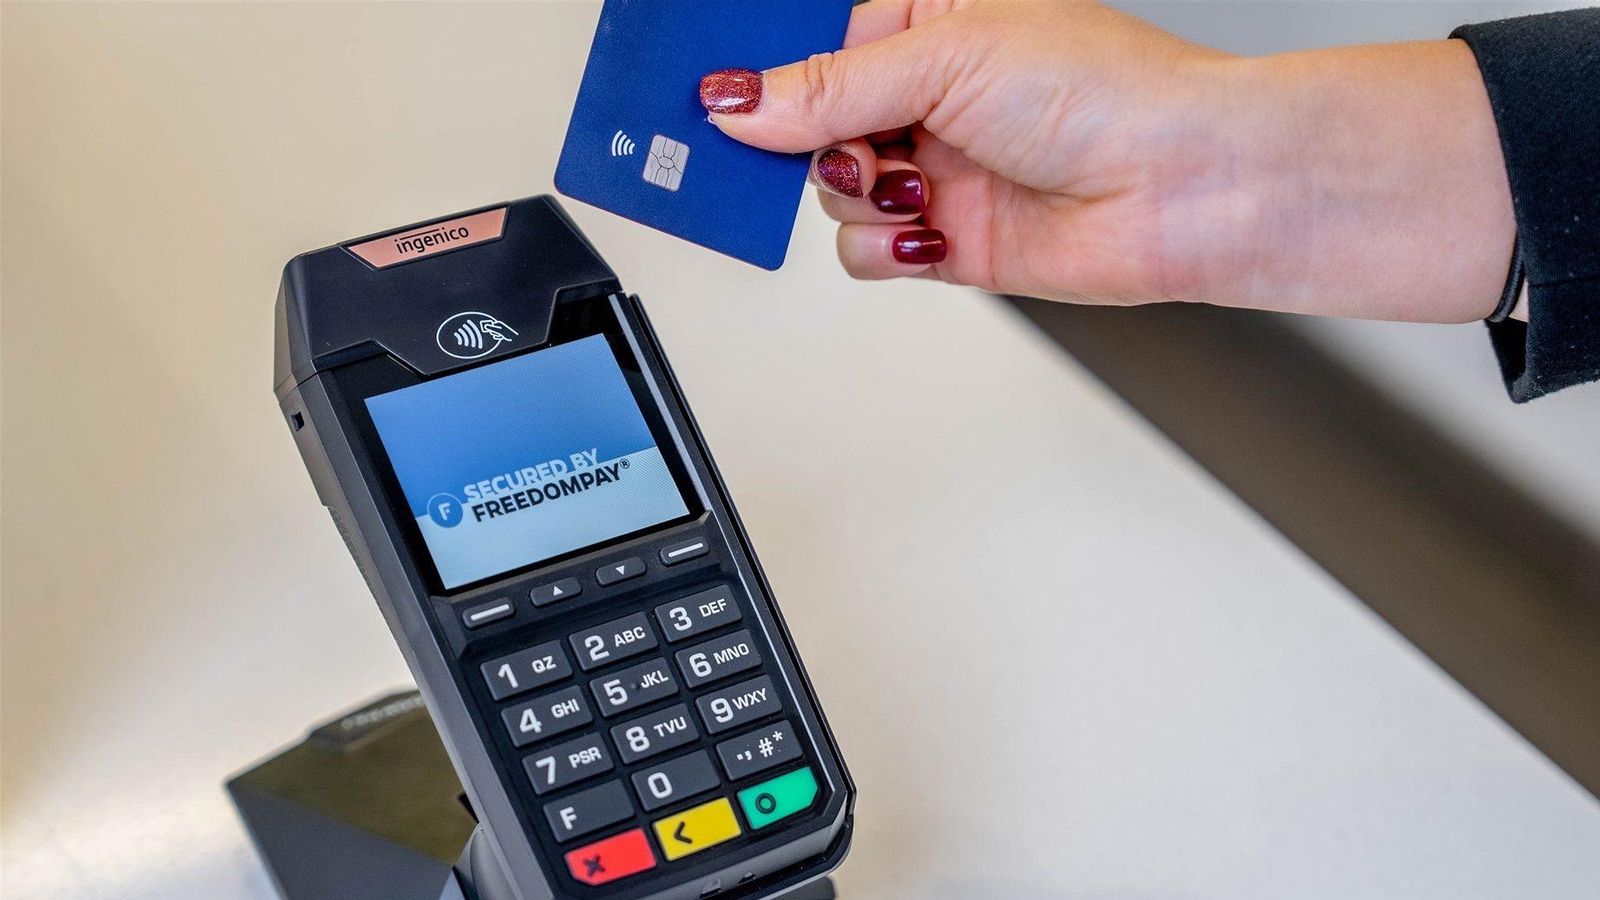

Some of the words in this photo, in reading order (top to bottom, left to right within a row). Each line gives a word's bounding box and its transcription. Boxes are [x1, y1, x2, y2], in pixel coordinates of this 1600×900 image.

[394, 224, 469, 255] ingenico
[463, 459, 569, 503] SECURED
[569, 448, 601, 471] BY
[669, 606, 693, 632] 3
[698, 598, 727, 618] DEF
[584, 634, 610, 661] 2
[613, 626, 646, 648] ABC
[689, 652, 712, 678] 6
[712, 642, 750, 665] MNO
[497, 662, 519, 689] 1
[531, 655, 556, 674] QZ
[603, 678, 628, 706] 5
[640, 669, 669, 689] JKL
[519, 708, 542, 734] 4
[550, 698, 580, 719] GHI
[710, 698, 734, 724] 9
[731, 687, 768, 711] WXY
[625, 725, 651, 752] 8
[653, 716, 687, 738] TVU
[535, 755, 557, 785] 7
[568, 746, 602, 769] PSR
[559, 806, 577, 831] F
